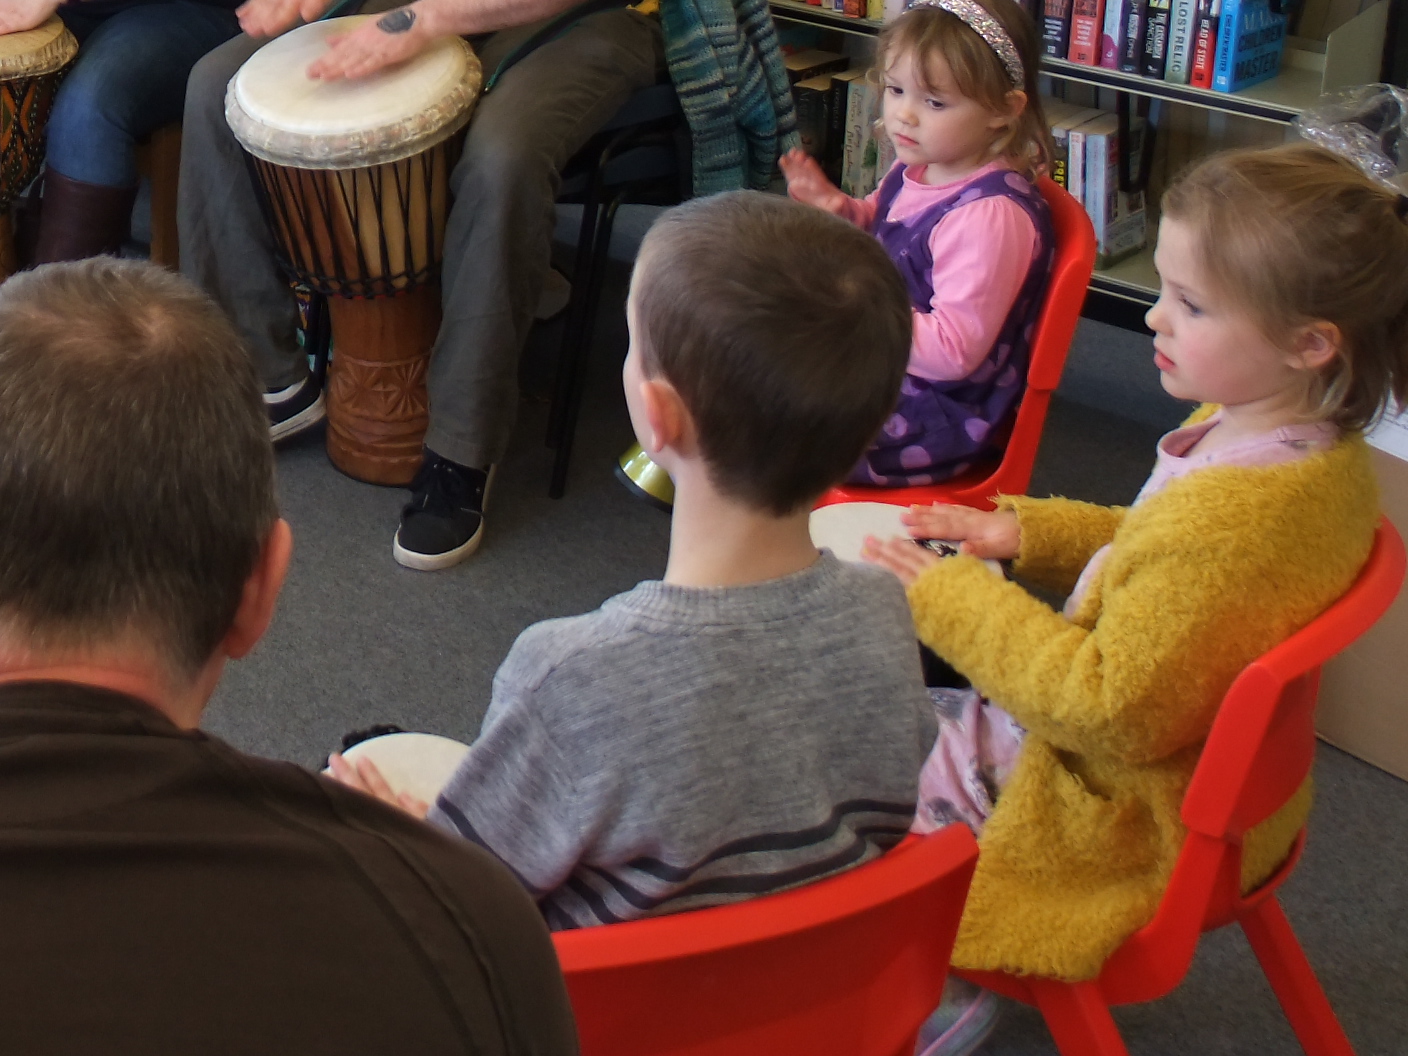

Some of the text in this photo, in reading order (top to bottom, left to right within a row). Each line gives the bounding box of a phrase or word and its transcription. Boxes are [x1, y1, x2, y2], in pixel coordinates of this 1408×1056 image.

[1171, 2, 1189, 72] LOST RELIC
[1198, 19, 1208, 42] HEAD
